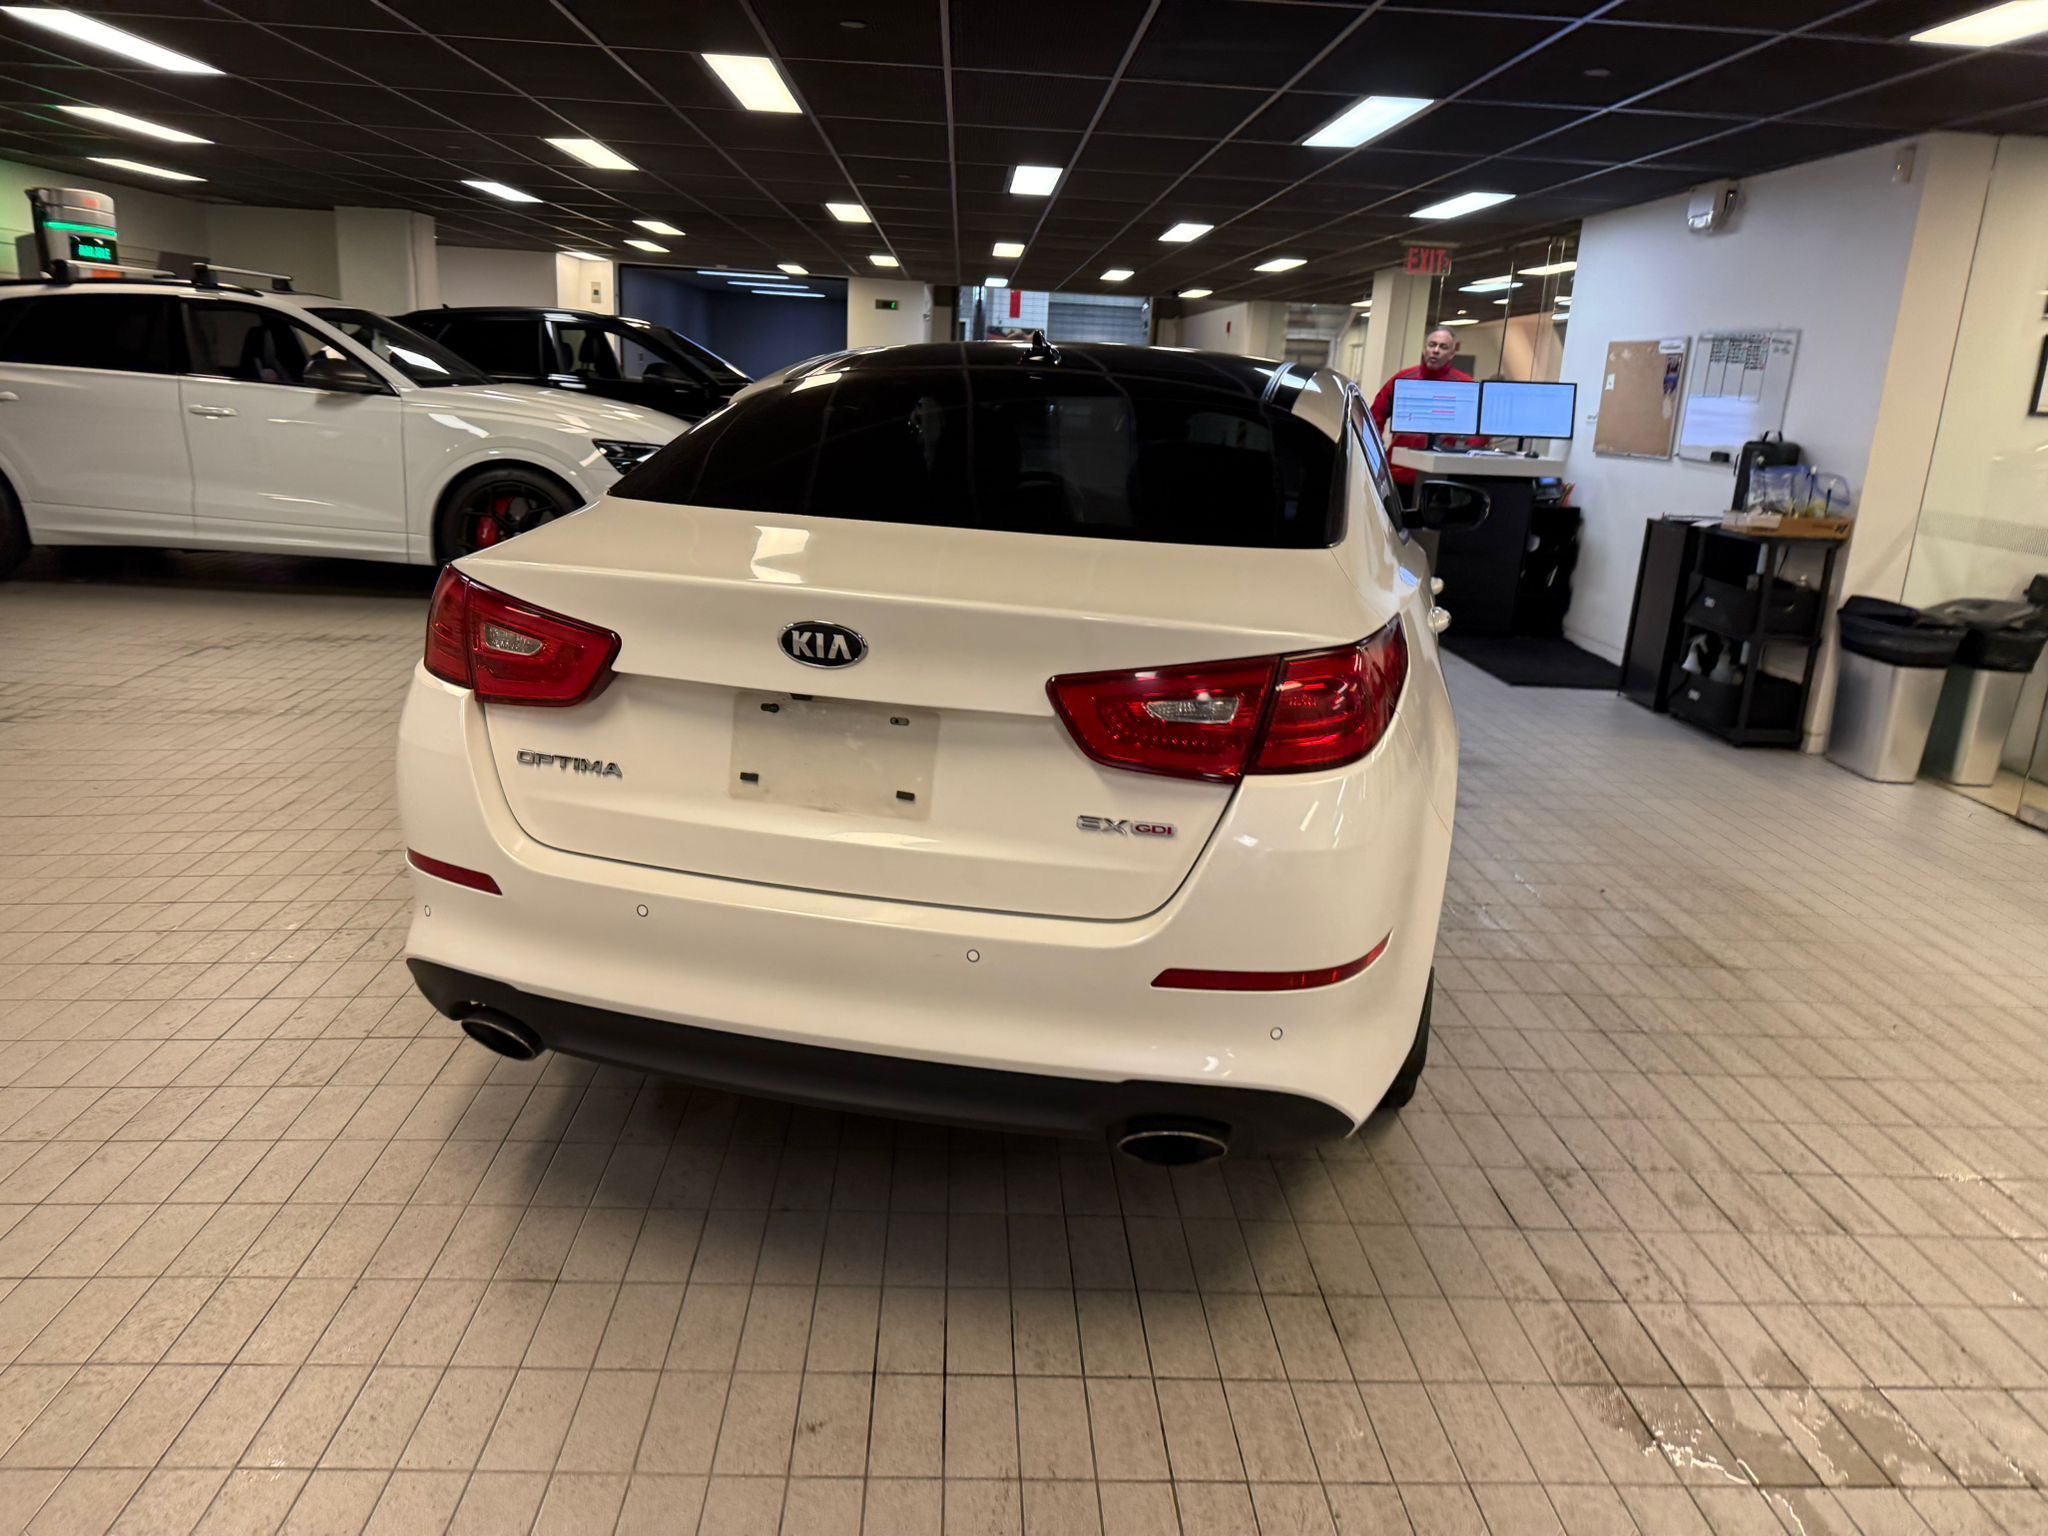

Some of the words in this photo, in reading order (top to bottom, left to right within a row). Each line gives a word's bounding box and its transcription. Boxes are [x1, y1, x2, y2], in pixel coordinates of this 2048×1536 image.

[1408, 247, 1447, 274] EXIT
[791, 630, 852, 660] KIA
[516, 748, 623, 778] OPTIMA
[1077, 815, 1128, 836] EX
[1134, 824, 1173, 835] GDI
